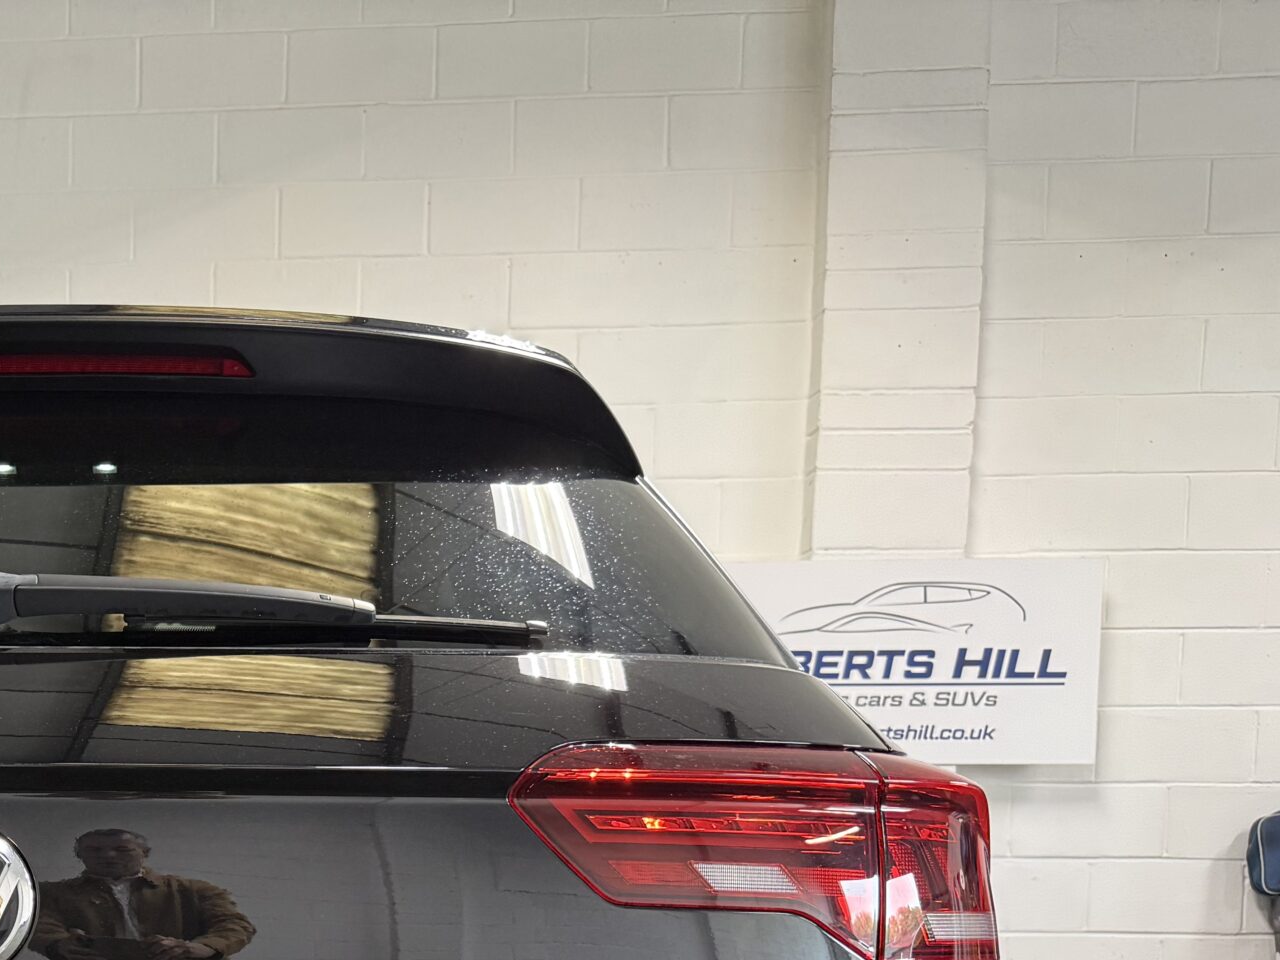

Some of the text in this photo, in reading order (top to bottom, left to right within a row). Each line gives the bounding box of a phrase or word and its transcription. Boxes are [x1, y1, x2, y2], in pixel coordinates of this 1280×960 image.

[952, 647, 1067, 679] HILL
[855, 691, 998, 708] cars & SUVs
[880, 725, 996, 741] tshill.co.uk
